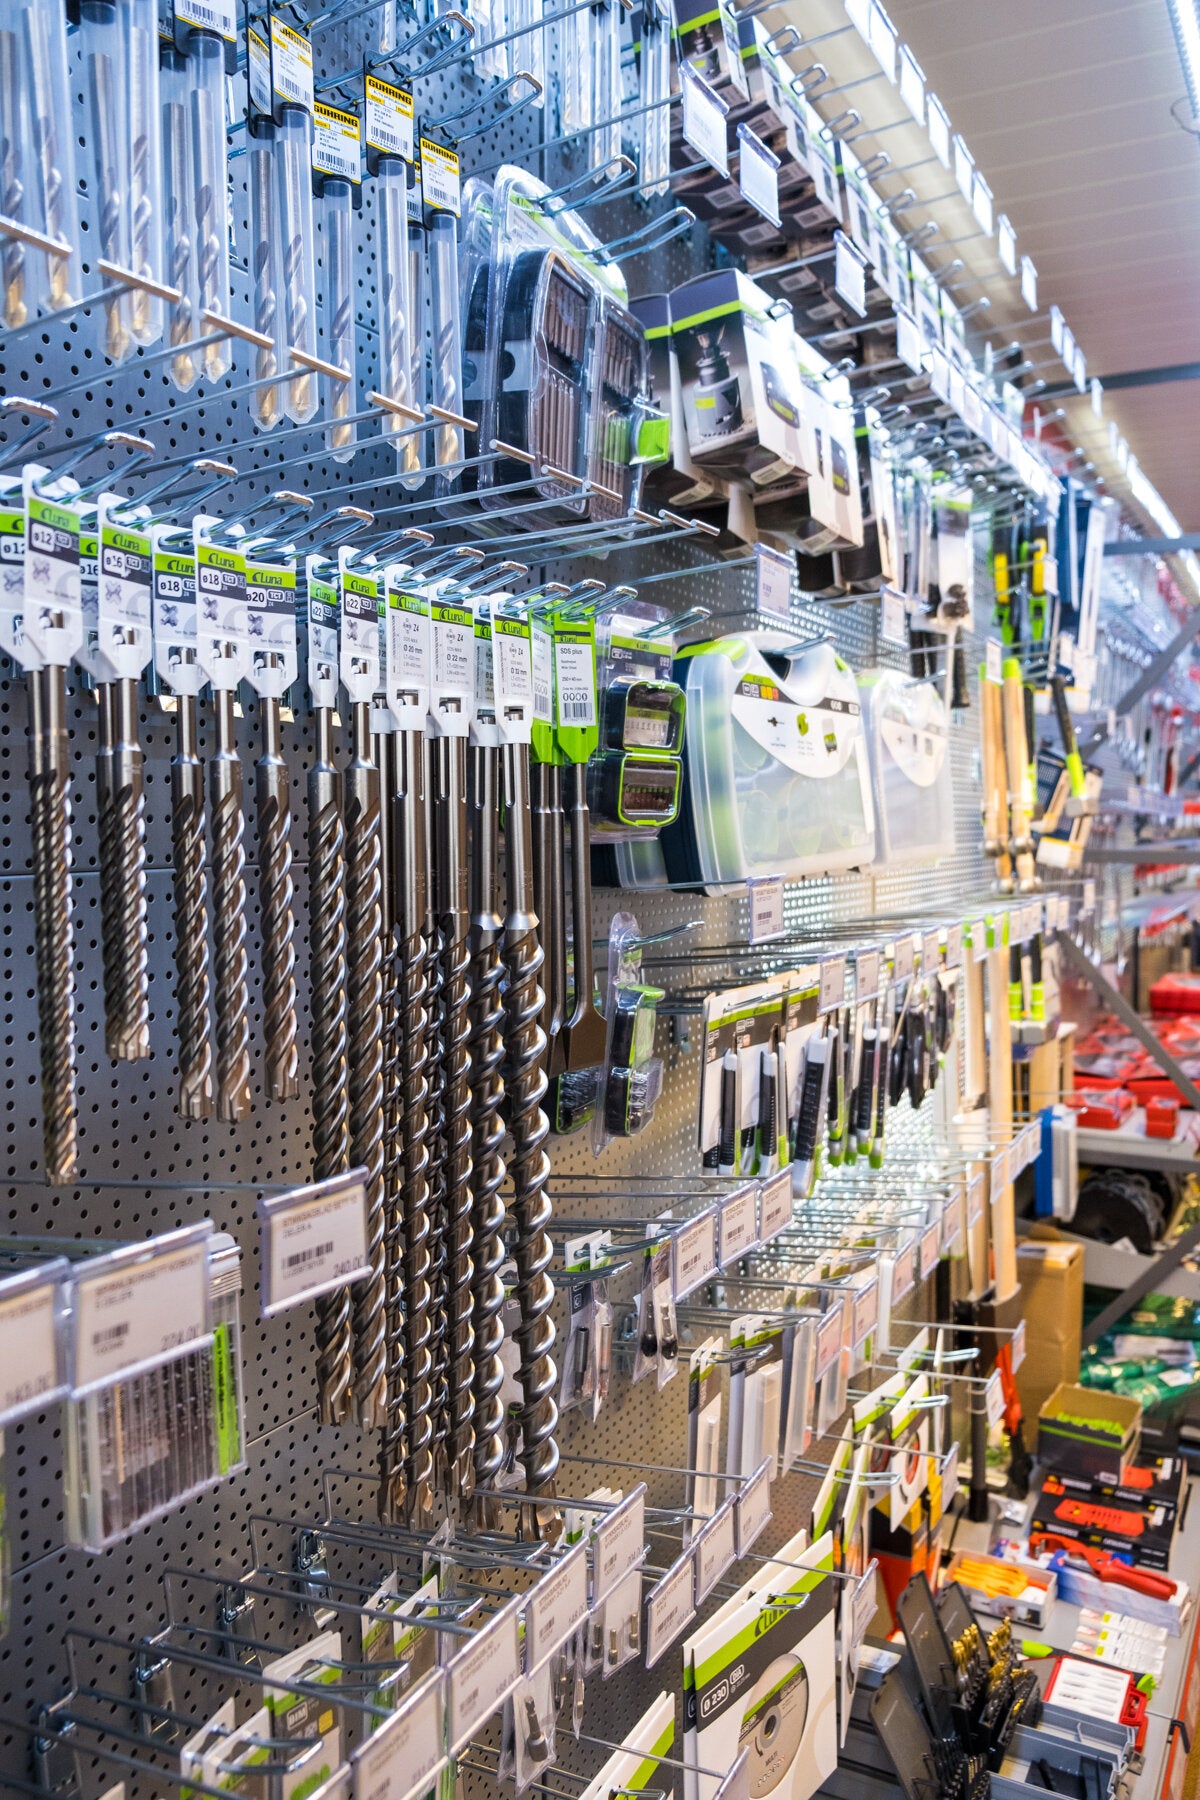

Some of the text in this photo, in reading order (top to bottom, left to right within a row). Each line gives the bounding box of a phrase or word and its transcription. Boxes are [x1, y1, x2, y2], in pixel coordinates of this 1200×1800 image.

[116, 534, 140, 551] Luna
[172, 560, 195, 576] Lun
[212, 553, 235, 569] Luna
[185, 581, 195, 589] TC
[256, 572, 283, 585] Luna
[353, 580, 370, 594] Luna
[444, 608, 464, 623] Luna
[711, 1686, 727, 1706] 230
